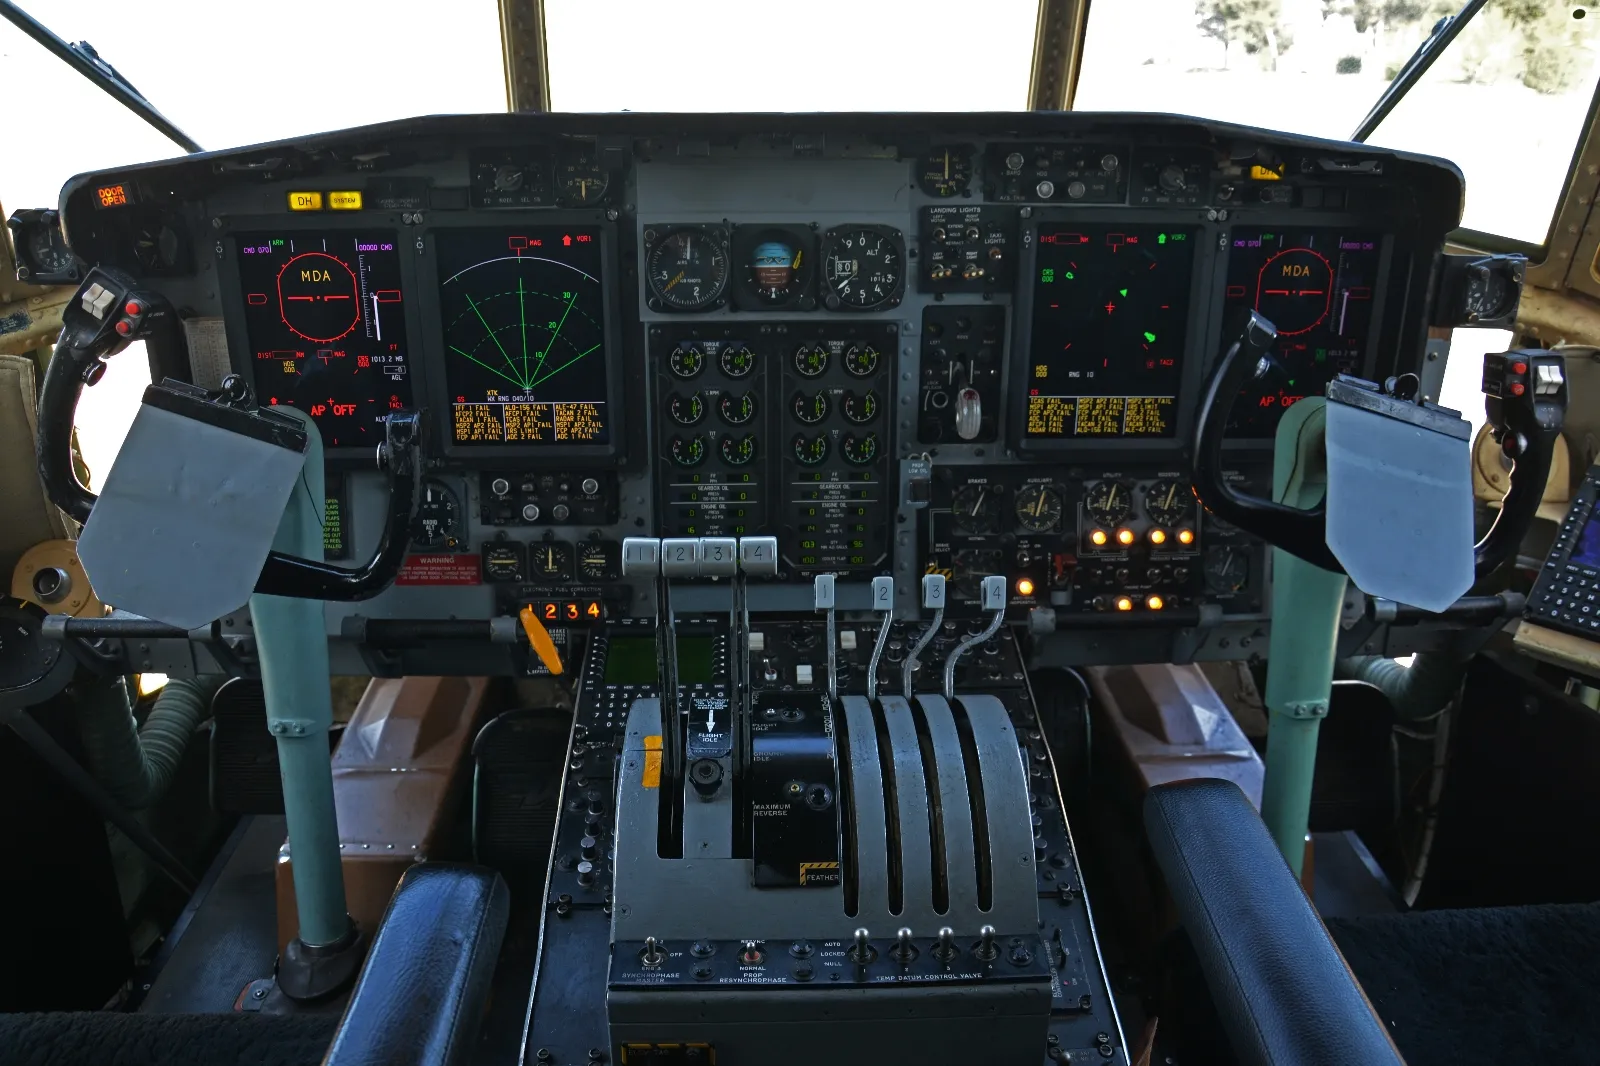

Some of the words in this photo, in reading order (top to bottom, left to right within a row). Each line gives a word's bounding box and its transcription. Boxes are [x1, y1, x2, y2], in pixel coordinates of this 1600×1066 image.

[98, 186, 124, 198] DOOR
[102, 195, 126, 206] OPEN
[298, 197, 313, 206] DH
[846, 240, 852, 248] 9
[860, 237, 865, 246] 0
[885, 255, 890, 263] 2
[301, 270, 331, 282] MDA
[662, 271, 667, 280] 3
[1283, 265, 1310, 277] MDA
[887, 274, 892, 283] 3
[694, 287, 699, 295] 2
[845, 285, 850, 293] 6
[875, 284, 880, 292] 4
[860, 290, 865, 298] 5
[1260, 397, 1275, 407] AP
[311, 405, 326, 415] AP
[333, 404, 356, 415] OFF
[744, 474, 749, 482] 0
[677, 548, 685, 561] 2
[714, 547, 723, 561] 3
[754, 546, 762, 560] 4
[880, 587, 888, 600] 2
[932, 585, 940, 599] 3
[993, 585, 1001, 599] 4
[545, 604, 556, 618] 2
[567, 605, 578, 619] 3
[588, 603, 599, 617] 4
